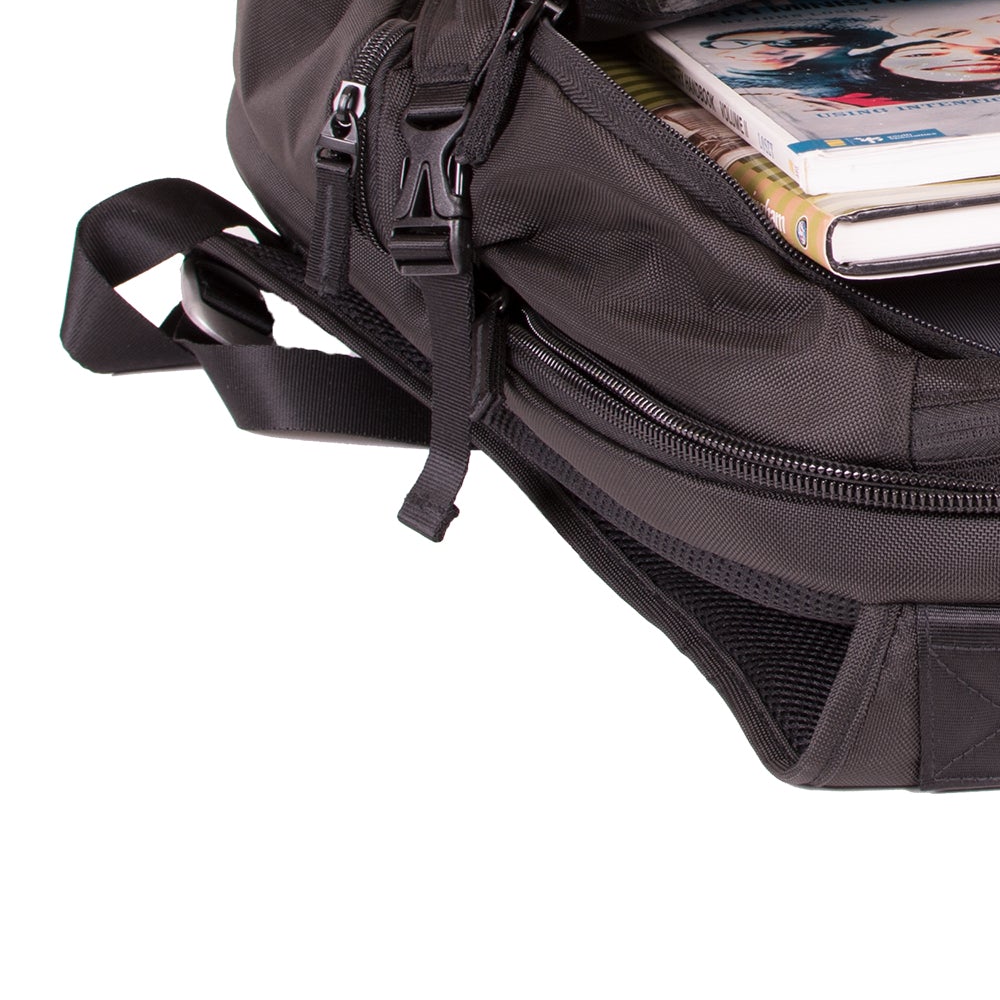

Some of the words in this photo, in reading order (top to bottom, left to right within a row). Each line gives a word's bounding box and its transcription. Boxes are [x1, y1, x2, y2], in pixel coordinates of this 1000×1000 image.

[683, 72, 717, 113] HANDBOOK
[719, 100, 744, 134] VOLUME
[816, 107, 888, 119] USING
